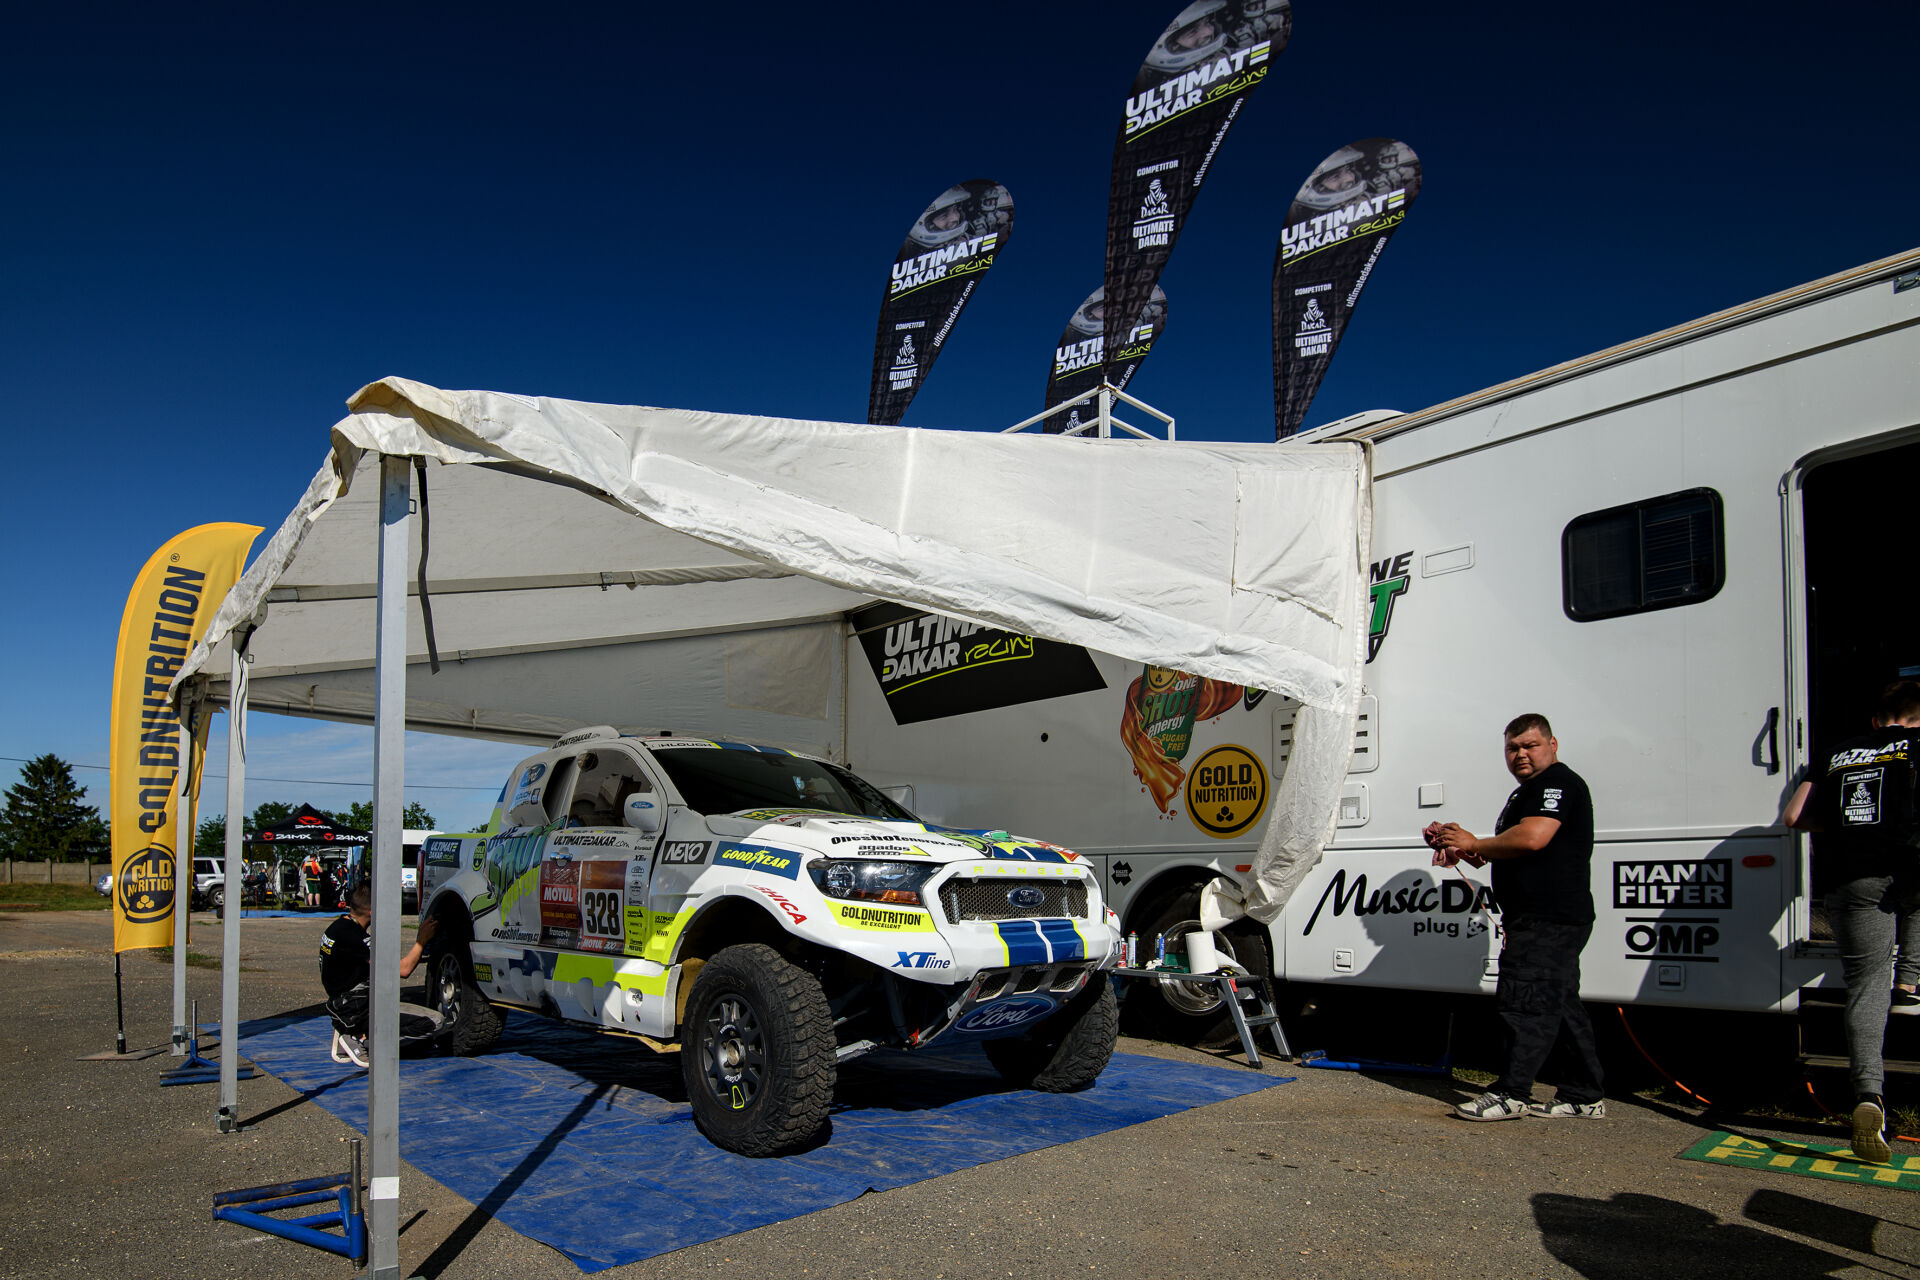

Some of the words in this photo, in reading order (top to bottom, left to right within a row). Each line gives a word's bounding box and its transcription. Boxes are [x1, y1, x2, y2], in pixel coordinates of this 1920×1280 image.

[1125, 40, 1271, 118] ULTIMATE
[1125, 88, 1203, 135] DAKAR
[1206, 66, 1268, 99] racing
[1193, 98, 1244, 187] ultimatedakar.com
[1136, 159, 1179, 177] COMPETITOR
[1140, 201, 1169, 218] DAKAR
[1281, 187, 1406, 245] ULTIMATE
[1132, 219, 1175, 238] ULTIMATE
[1282, 225, 1349, 260] DAKAR
[1352, 209, 1406, 236] racing
[1138, 233, 1169, 250] DAKAR
[892, 232, 998, 281] ULTIMATE
[890, 264, 947, 294] DAKAR
[949, 254, 994, 276] racing
[1346, 236, 1388, 308] ultimatedakar.com
[1294, 283, 1332, 296] COMPETITOR
[933, 280, 975, 347] ultimatedakar.com
[895, 320, 926, 331] COMPETITOR
[1301, 318, 1327, 331] DAKAR
[1295, 332, 1332, 348] ULTIMATE
[1300, 343, 1328, 358] DAKAR
[889, 368, 918, 381] ULTIMATE
[892, 378, 913, 391] DAKAR
[1370, 550, 1414, 583] NE
[881, 642, 961, 683] DAKAR
[1175, 675, 1198, 691] ONE
[1140, 687, 1195, 730] SHOT
[1147, 715, 1186, 739] energy
[1167, 742, 1186, 752] FREE
[1200, 763, 1252, 787] GOLD
[1195, 786, 1257, 804] NUTRITION
[1845, 806, 1876, 816] ULTIMATE
[335, 834, 369, 842] 24MX
[664, 842, 705, 863] NEXO
[721, 849, 791, 870] GOODYEAR
[973, 866, 1081, 875] RANGER
[1619, 863, 1725, 883] MANN
[543, 886, 574, 902] MOTUL
[1619, 885, 1725, 904] FILTER
[584, 891, 621, 936] 328
[870, 921, 901, 930] EXCELLENT
[1413, 917, 1460, 938] plug
[582, 938, 602, 949] MOTUL
[1625, 924, 1720, 954] OMP
[475, 964, 492, 973] MANN
[890, 951, 951, 969] XTline
[475, 973, 493, 981] FILTER
[966, 999, 1040, 1028] Ford
